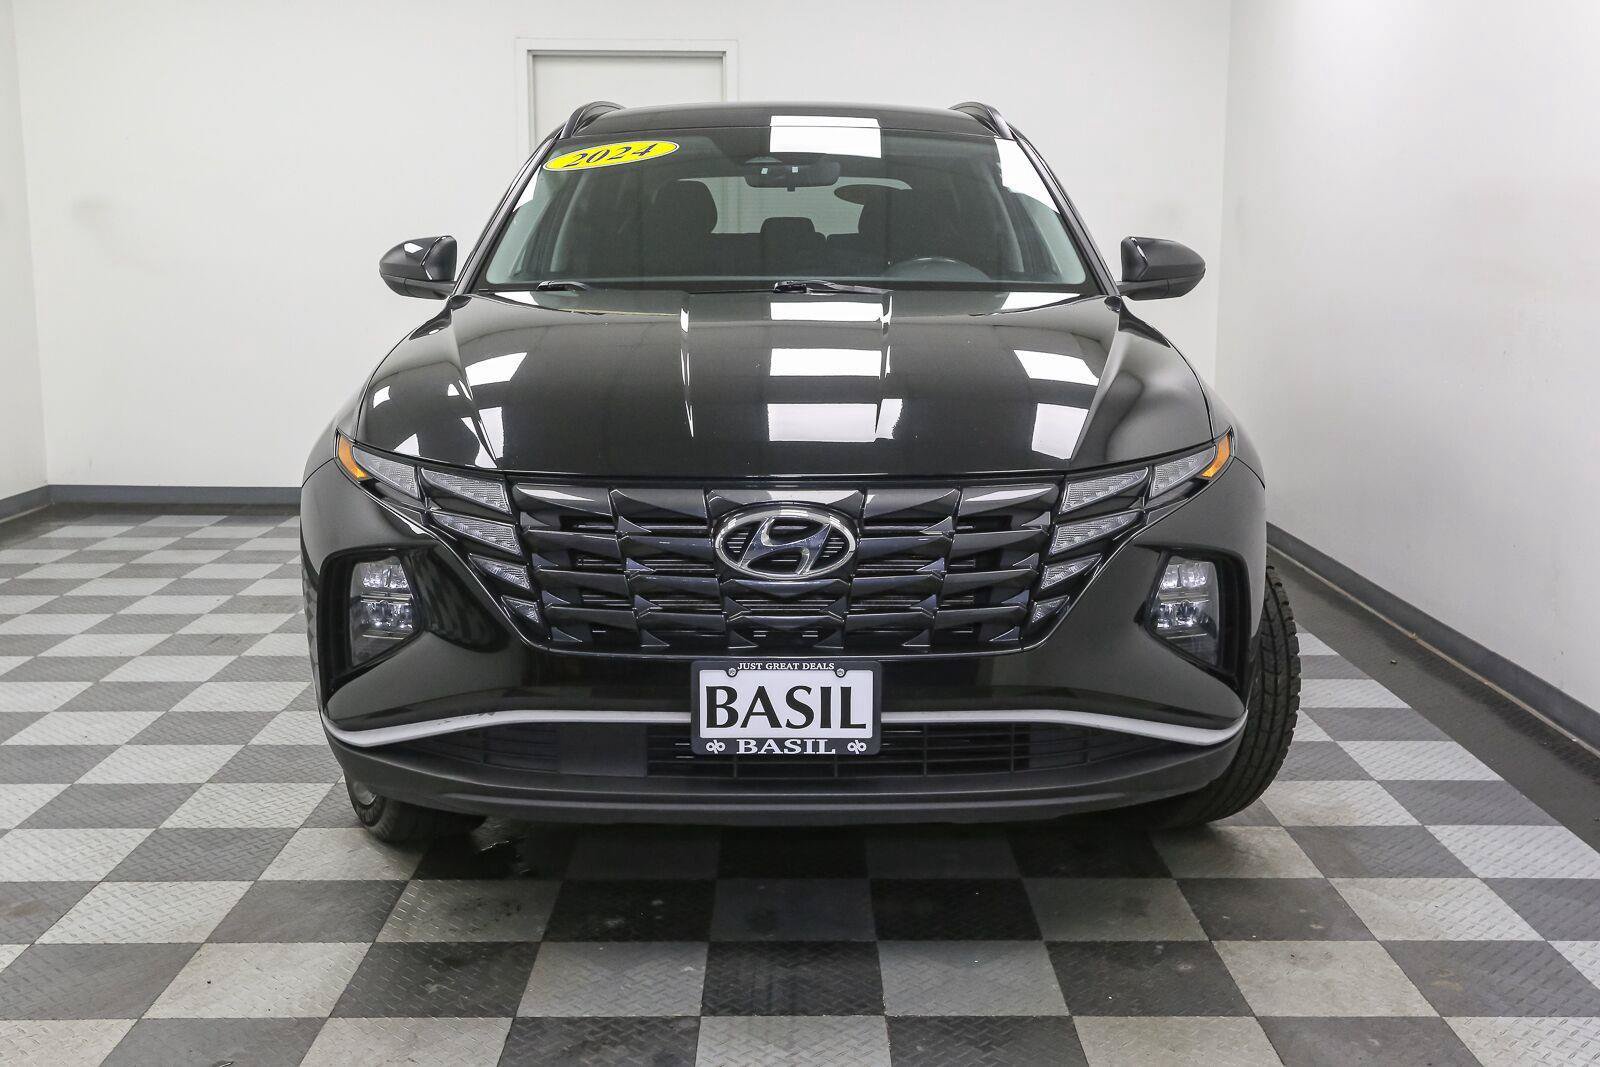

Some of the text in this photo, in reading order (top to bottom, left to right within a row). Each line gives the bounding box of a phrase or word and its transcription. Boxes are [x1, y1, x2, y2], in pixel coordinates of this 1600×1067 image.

[563, 143, 658, 168] 2024
[737, 662, 835, 670] JUST GREAT DEALS
[705, 685, 867, 729] BASIL
[736, 738, 836, 755] BASIL
